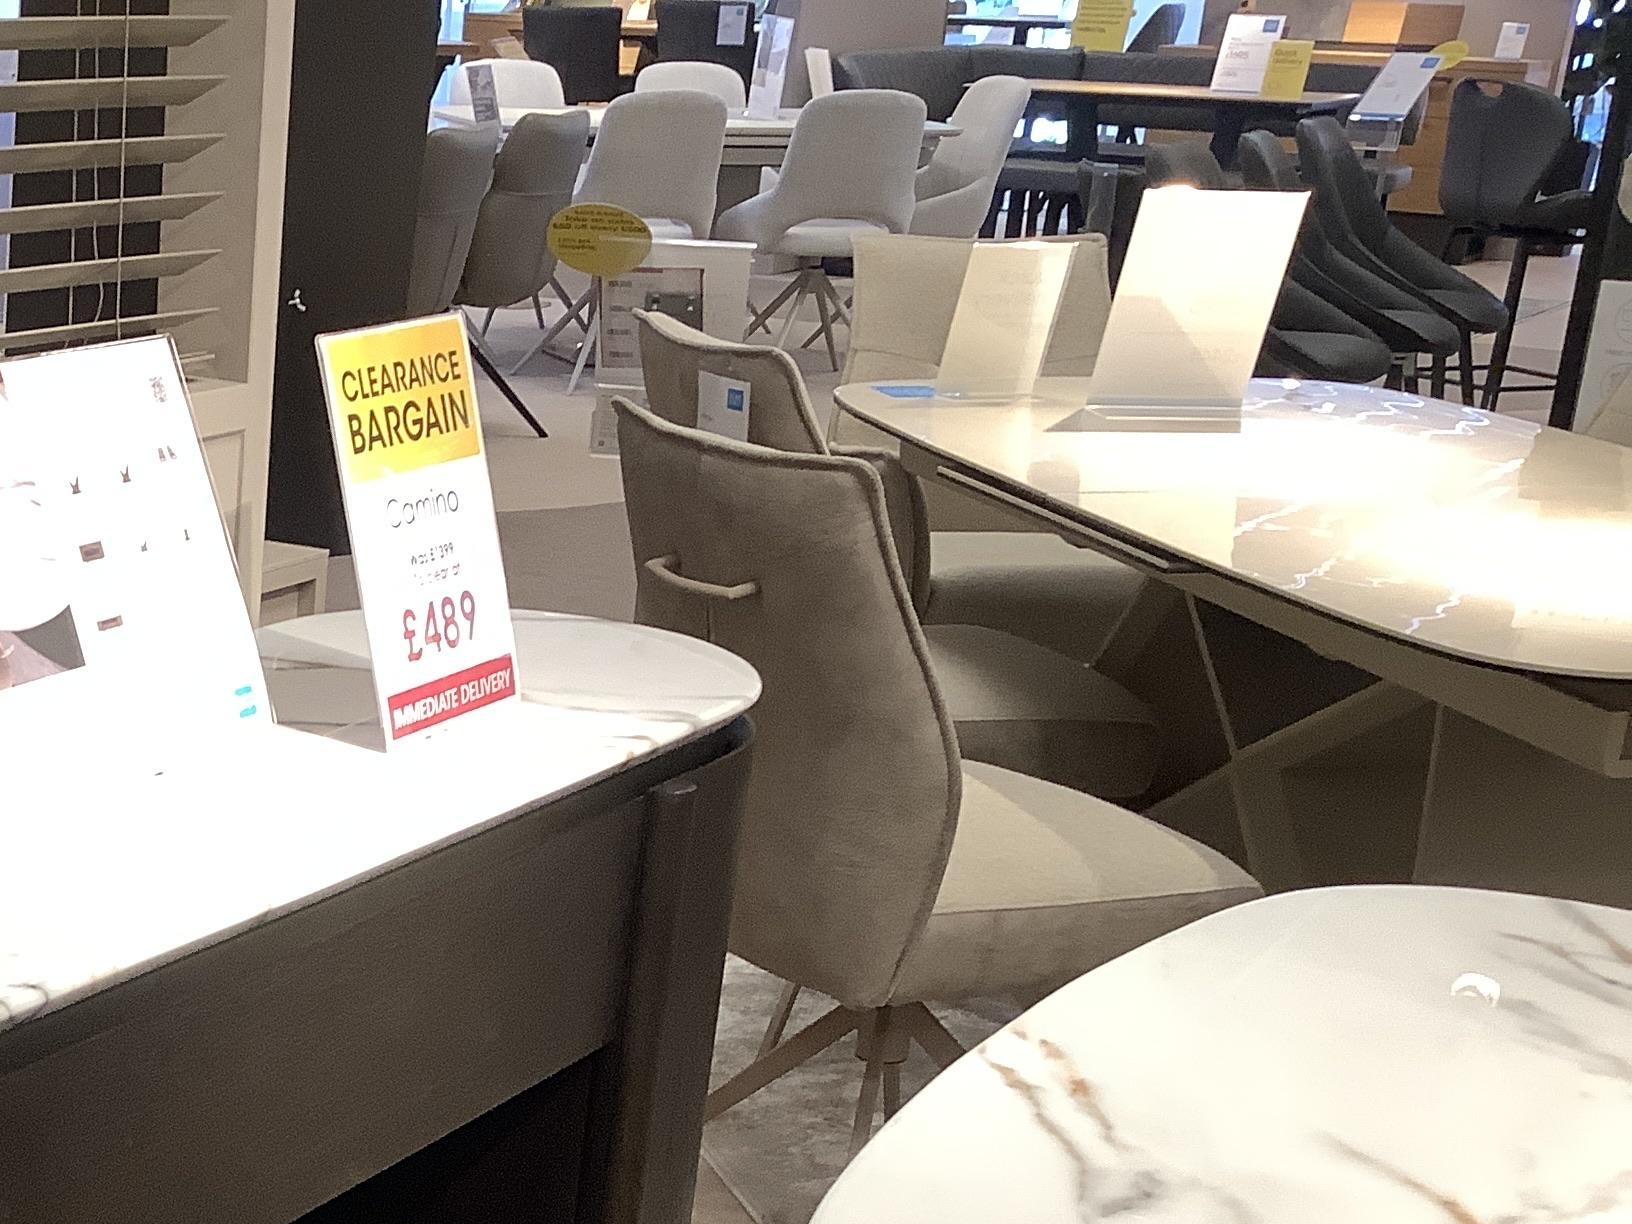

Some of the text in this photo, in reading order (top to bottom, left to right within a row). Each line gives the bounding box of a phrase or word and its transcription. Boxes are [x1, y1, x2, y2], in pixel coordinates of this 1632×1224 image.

[341, 349, 462, 402] CLEARANCE
[347, 389, 471, 455] BARGAIN
[386, 489, 459, 528] Camino
[403, 590, 475, 662] £489
[393, 668, 511, 730] IMMEDIATE DELIVERY
